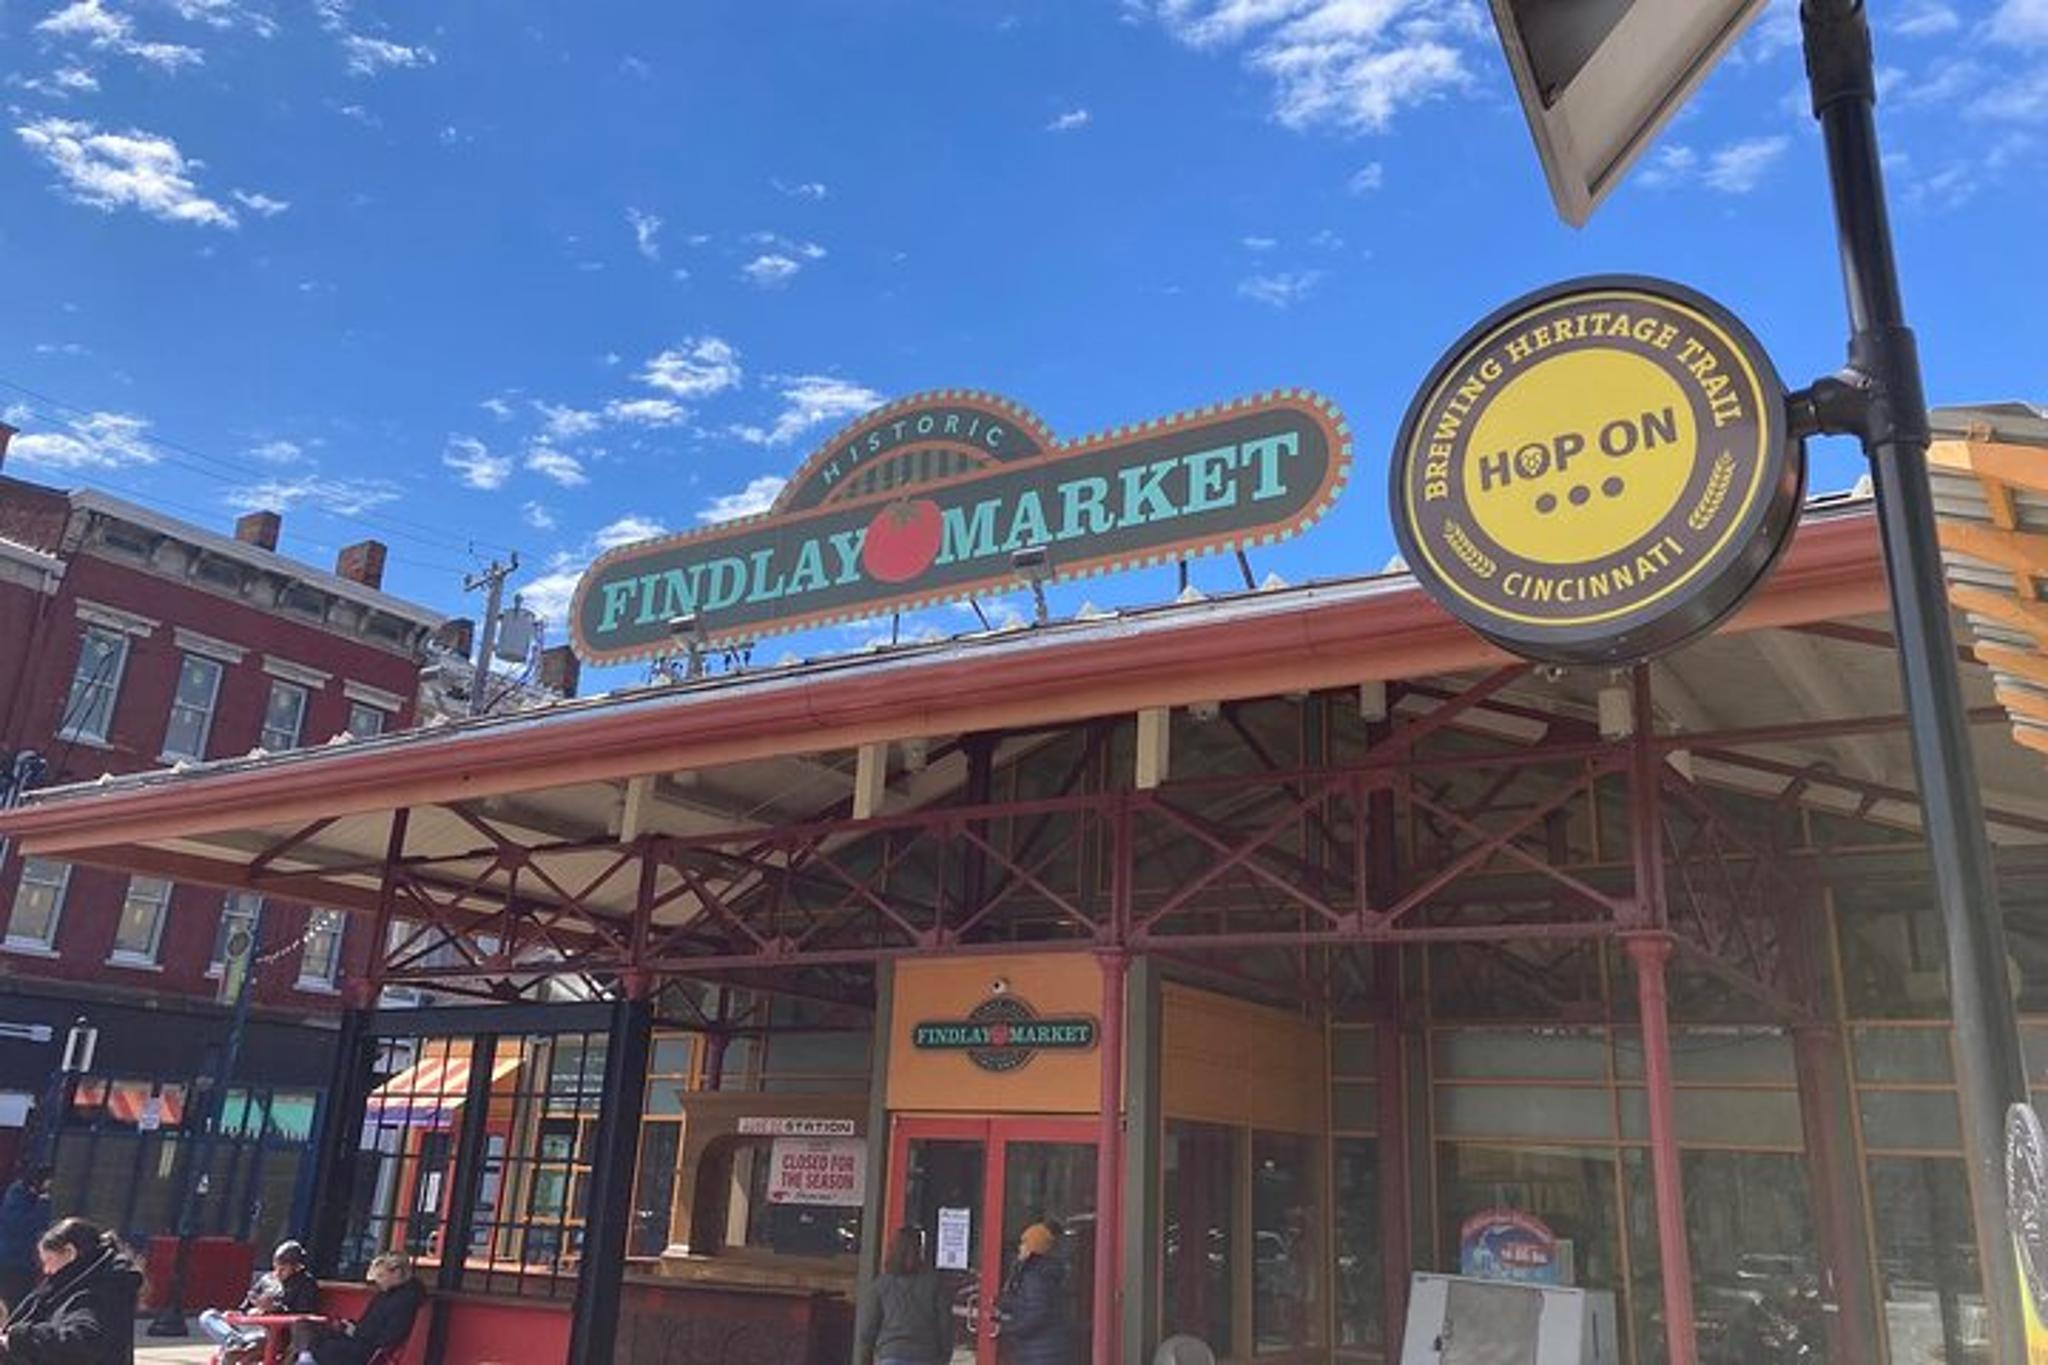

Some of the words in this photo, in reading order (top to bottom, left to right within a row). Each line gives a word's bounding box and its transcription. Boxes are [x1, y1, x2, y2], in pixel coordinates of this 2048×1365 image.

[1425, 358, 1503, 502] BREWING
[1505, 312, 1679, 366] HERITAGE
[1676, 338, 1744, 428] TRAIL
[822, 415, 1004, 486] HISTORIC
[1478, 433, 1585, 492] HOP
[1600, 407, 1679, 458] ON
[597, 527, 868, 633] FINDLAY
[935, 432, 1299, 565] MARKET
[1503, 536, 1684, 602] CINCINNATI
[917, 1027, 990, 1045] FINDLAY
[1009, 1025, 1090, 1043] MARKET
[785, 1121, 852, 1133] STATION
[781, 1171, 802, 1188] THE
[805, 1173, 854, 1190] SEASON
[782, 1153, 828, 1171] CLOSED
[830, 1155, 855, 1172] FOR
